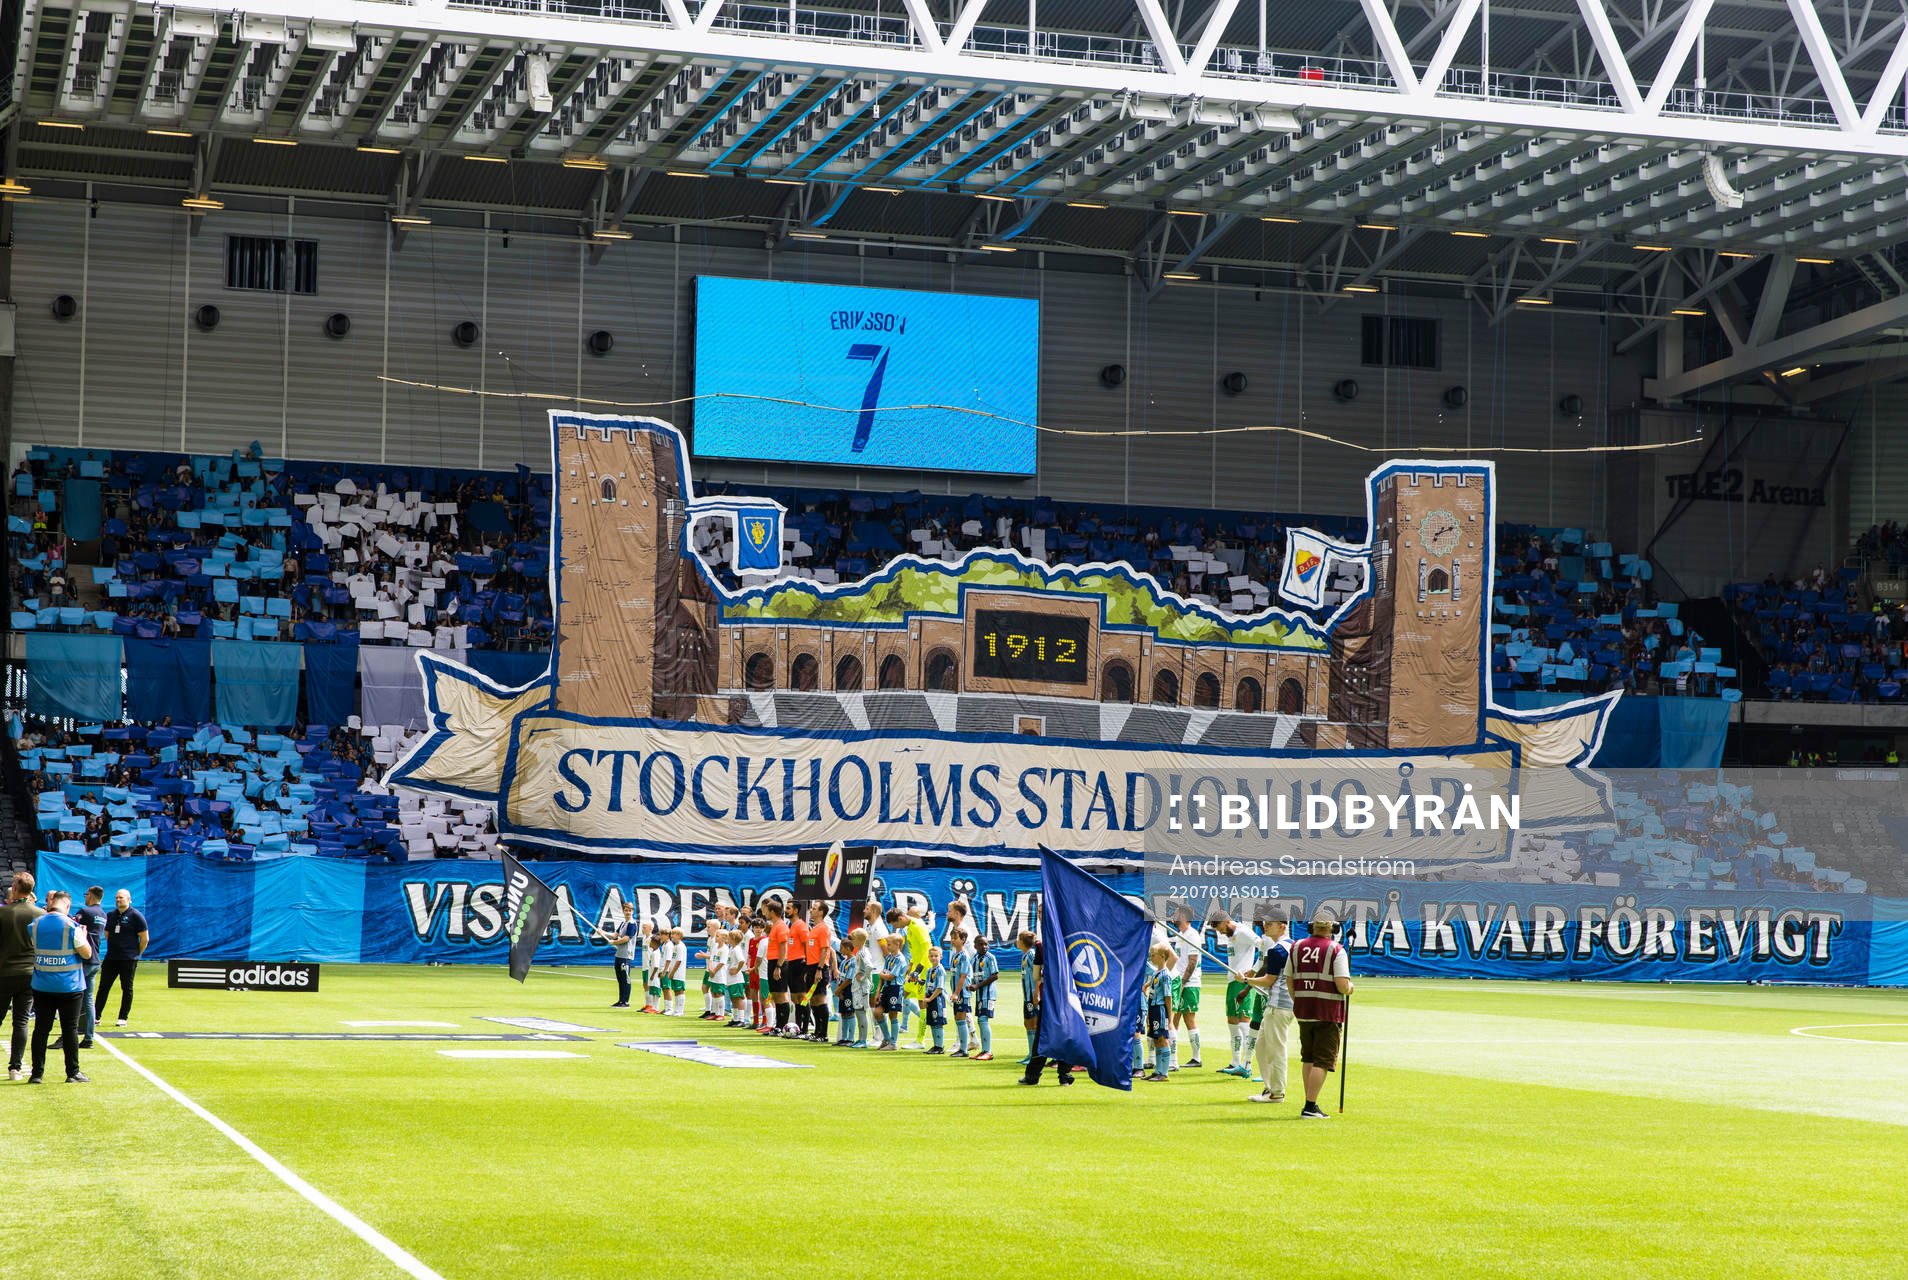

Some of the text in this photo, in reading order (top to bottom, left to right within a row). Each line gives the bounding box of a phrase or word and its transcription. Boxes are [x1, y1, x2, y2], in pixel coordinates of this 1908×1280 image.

[846, 344, 890, 453] 7
[1665, 468, 1826, 506] TELE2 Arena
[1876, 582, 1900, 592] B314
[984, 632, 1077, 663] 1912
[553, 748, 1001, 829] STOCKHOLMS
[1015, 766, 1273, 840] STADION
[800, 861, 822, 876] UNIBET
[846, 859, 869, 875] UNIBET
[403, 880, 582, 943] VISA
[1421, 901, 1568, 954] KVAR
[1576, 895, 1680, 956] FÖR
[1686, 904, 1843, 960] EVIGT
[43, 957, 67, 965] MEDIA
[1301, 947, 1319, 963] 24
[229, 965, 309, 986] adidas
[1304, 980, 1315, 989] TV
